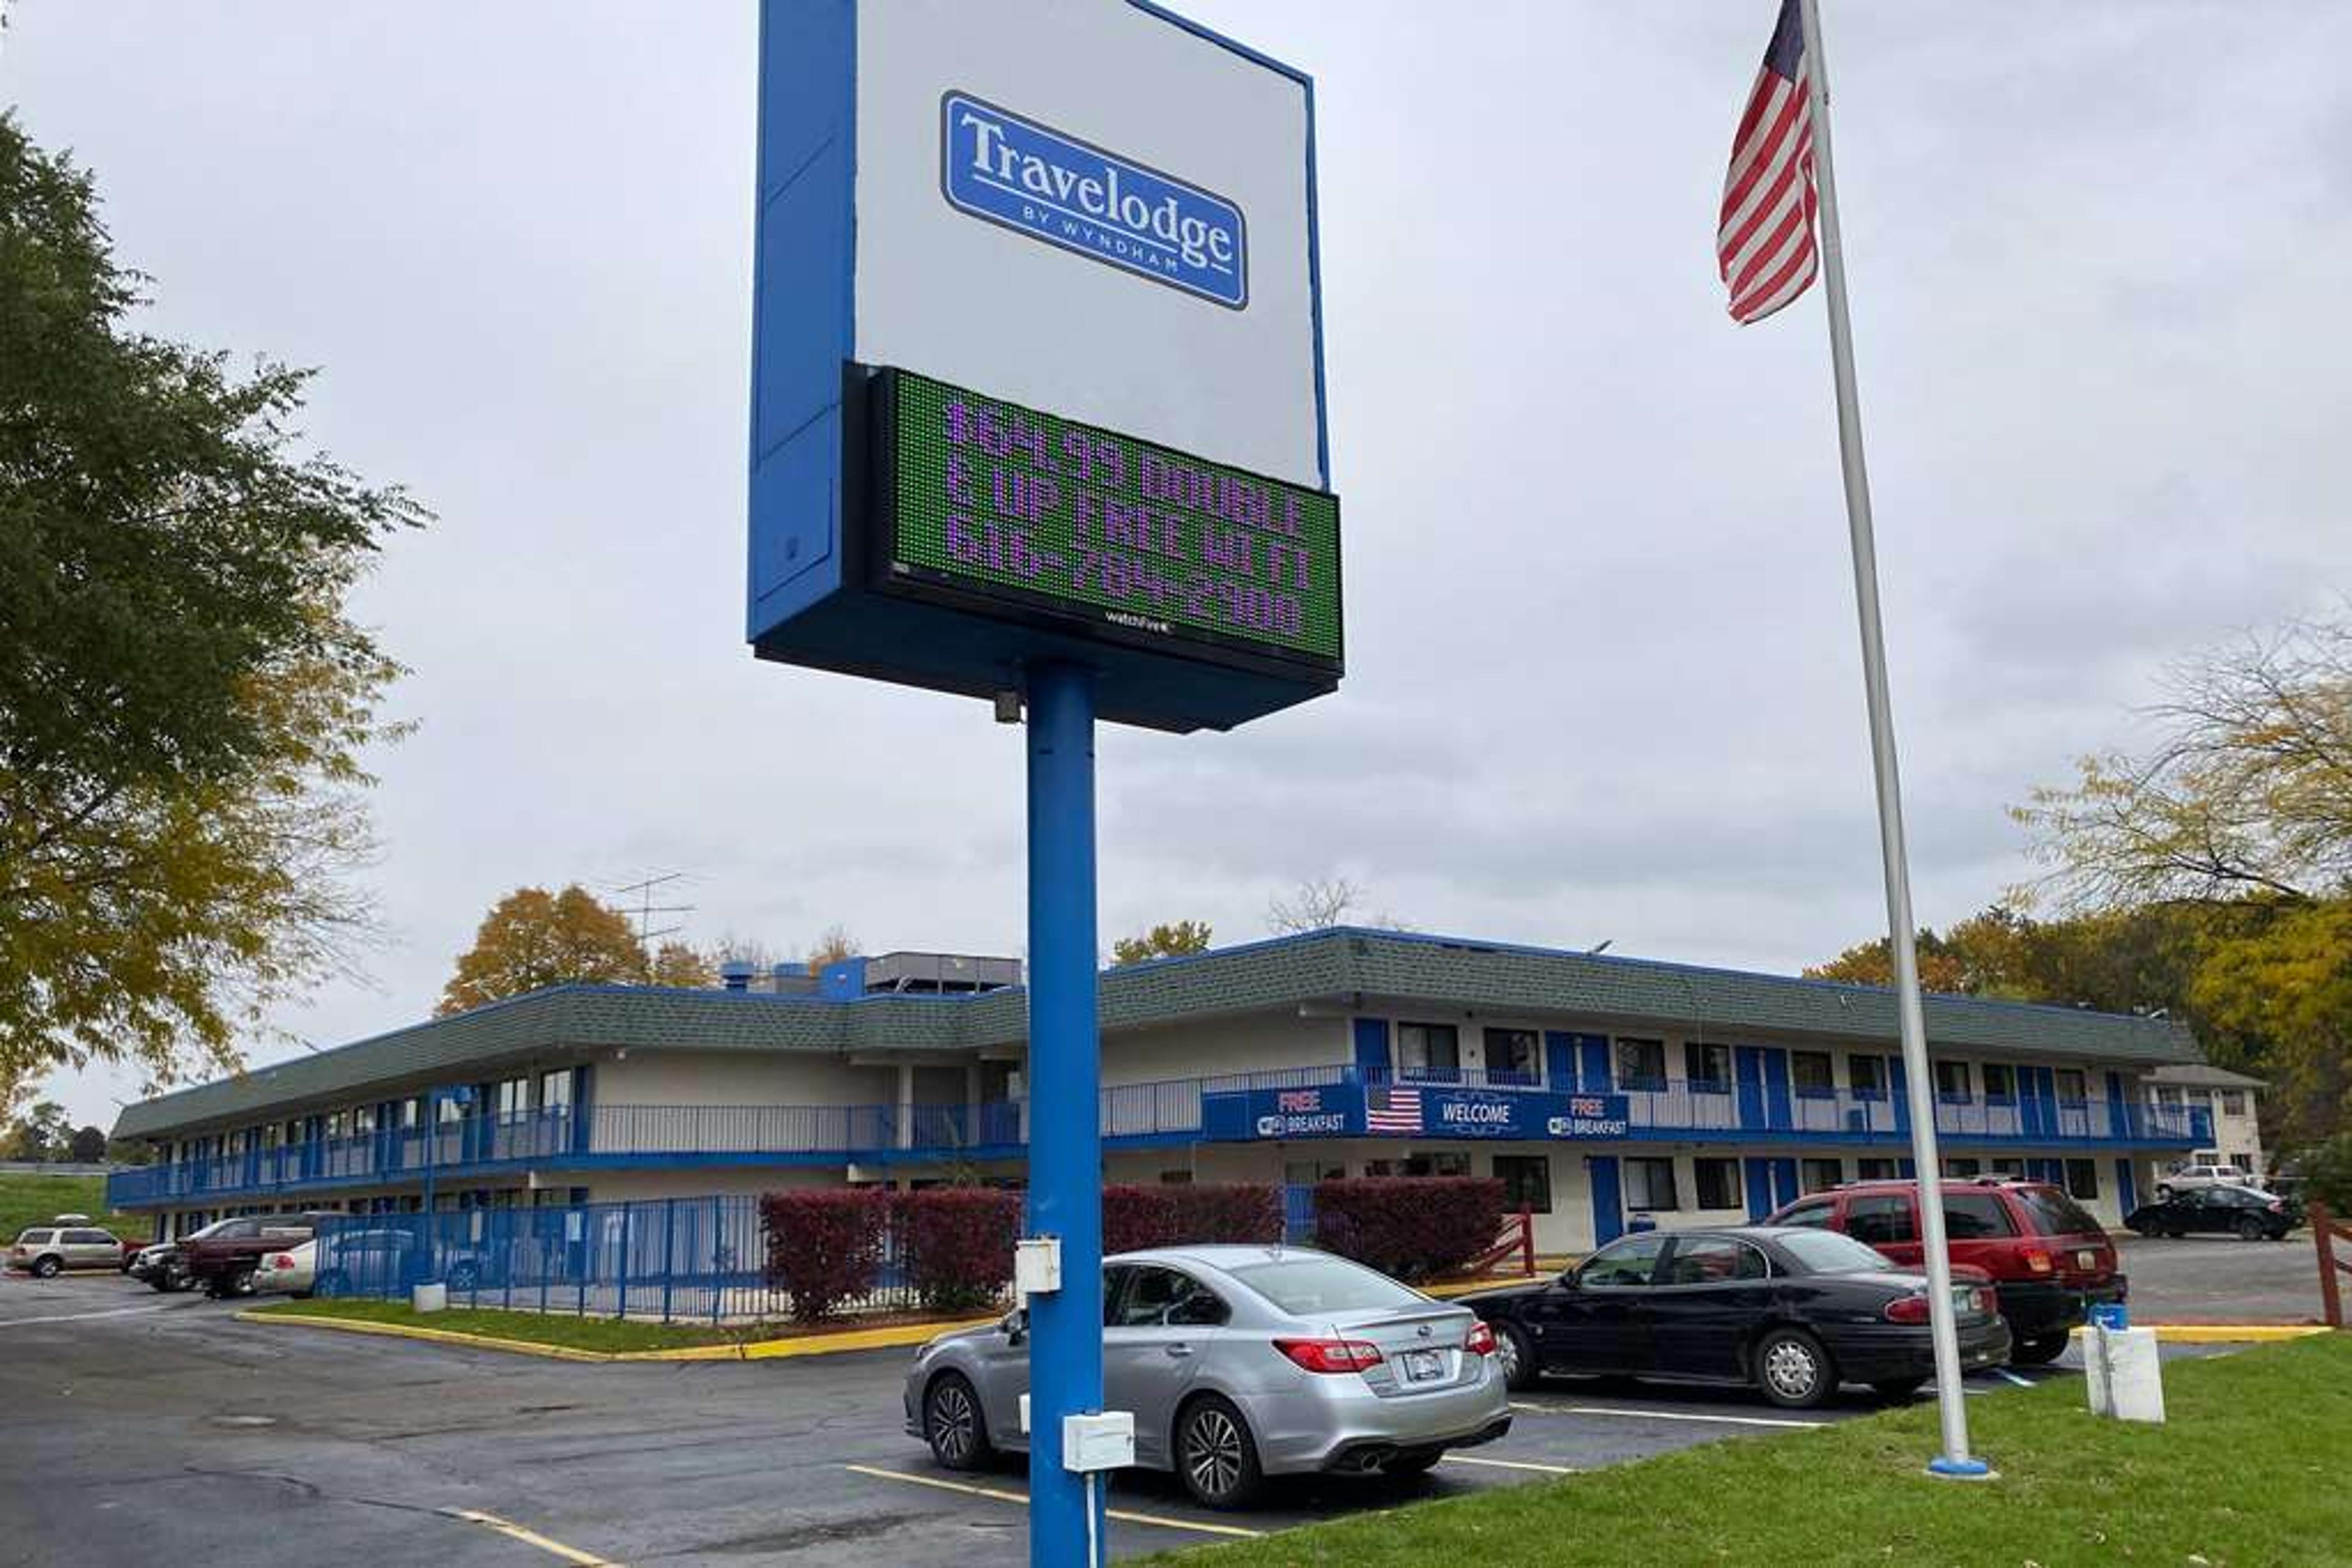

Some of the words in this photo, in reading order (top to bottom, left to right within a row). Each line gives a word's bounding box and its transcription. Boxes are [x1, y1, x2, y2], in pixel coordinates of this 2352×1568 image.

[960, 112, 1232, 268] Travelodge
[1022, 205, 1049, 225] BY
[1063, 221, 1178, 272] WYNDHAM
[1140, 452, 1302, 538] DOUBLE
[992, 468, 1060, 522] UP
[1073, 485, 1187, 560] FREE
[1278, 1091, 1321, 1113] FREE
[1442, 1102, 1510, 1123] WELCOME
[1571, 1098, 1604, 1117] FREE
[1287, 1114, 1343, 1133] BREAKFAST
[1574, 1118, 1626, 1134] BREAKFAST
